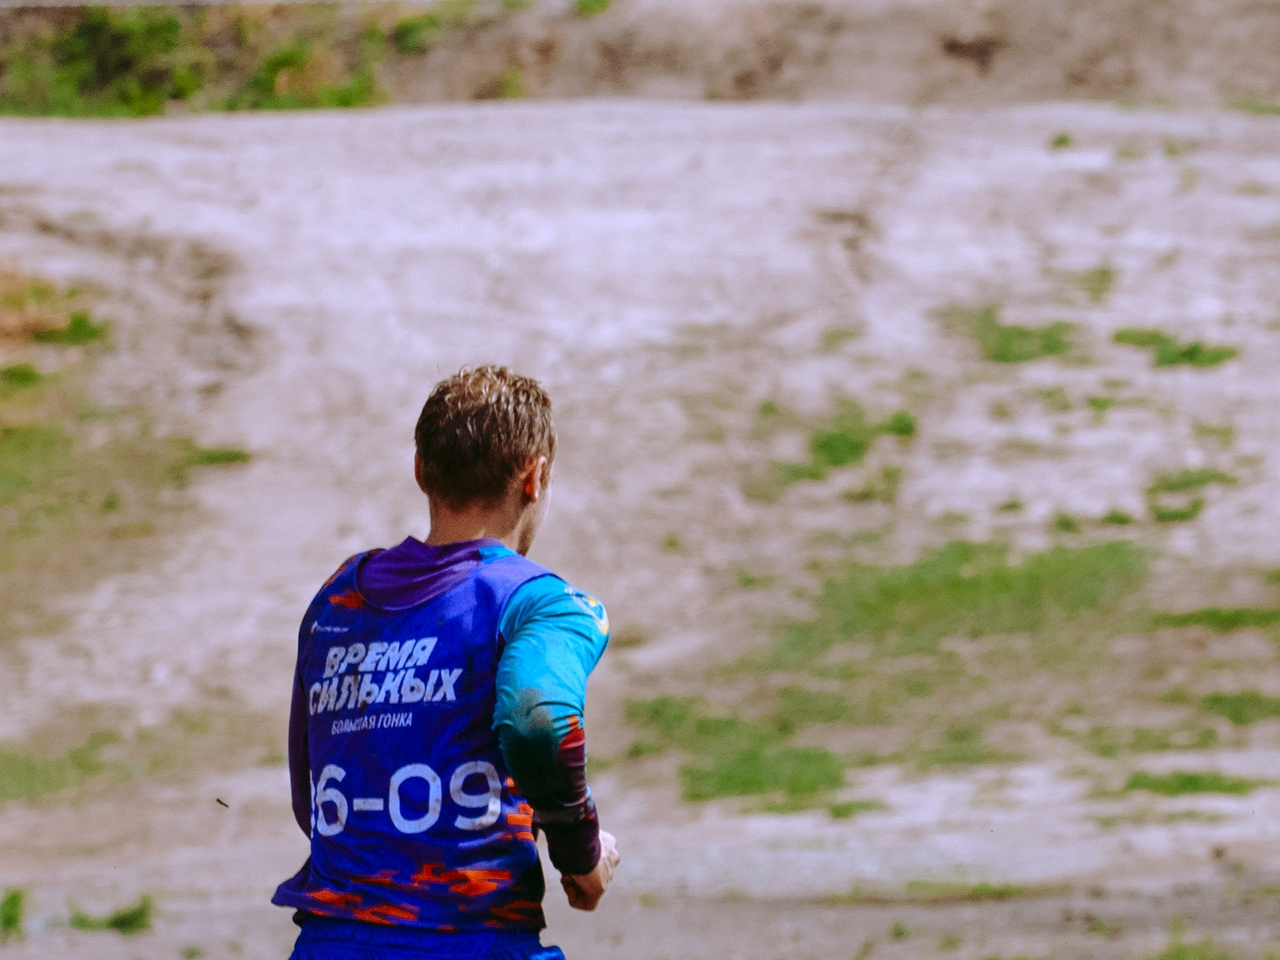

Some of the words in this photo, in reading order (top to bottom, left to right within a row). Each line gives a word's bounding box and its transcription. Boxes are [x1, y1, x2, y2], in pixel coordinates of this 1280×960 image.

[323, 636, 438, 679] ВРЕМЯ
[308, 667, 464, 717] СИЛЬНЫХ
[377, 711, 413, 729] ГОНКА
[309, 760, 502, 840] 6-09
